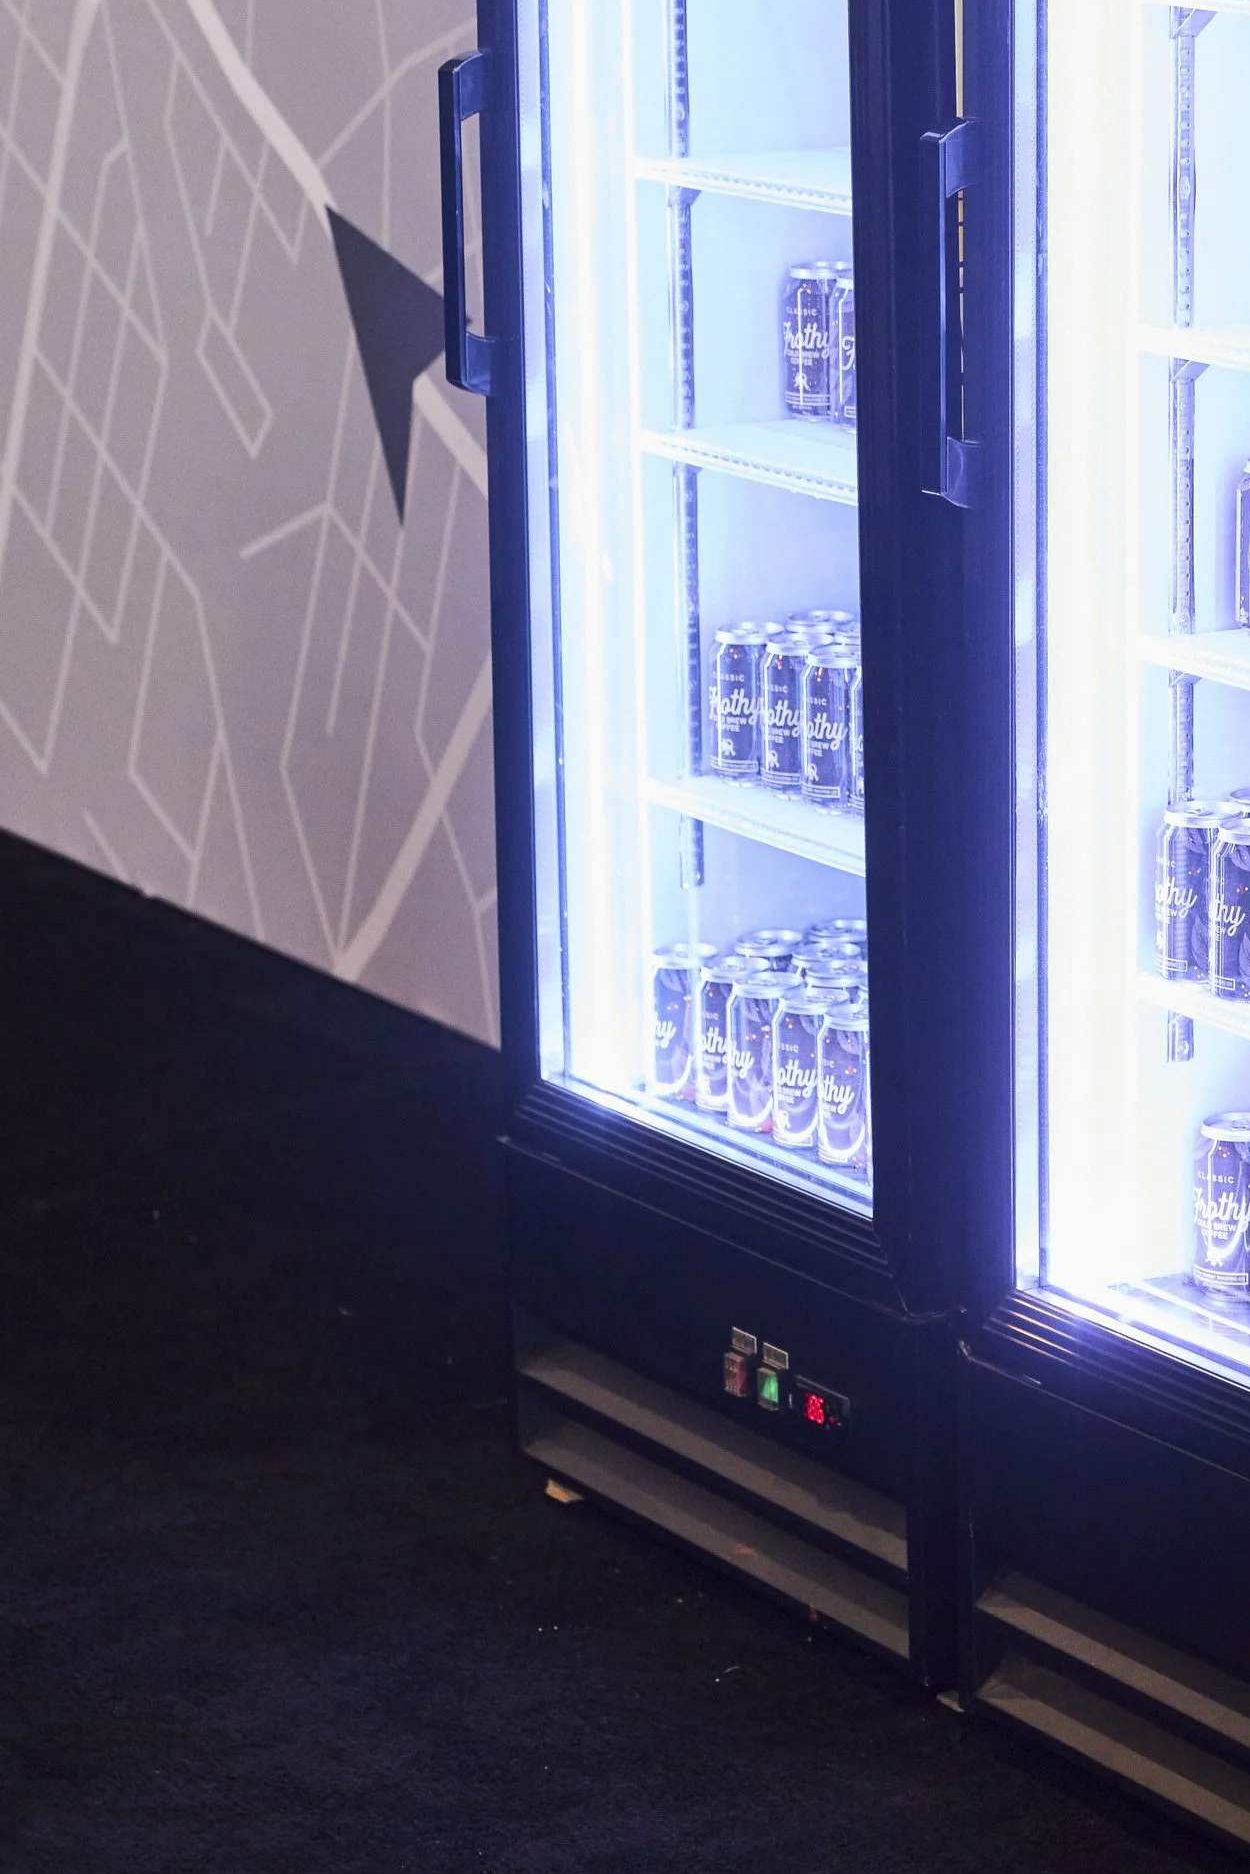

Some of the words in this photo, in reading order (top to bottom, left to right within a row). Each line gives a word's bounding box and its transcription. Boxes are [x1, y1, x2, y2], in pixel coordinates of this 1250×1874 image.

[712, 672, 745, 682] CSSIC
[762, 699, 804, 738] othy
[804, 712, 849, 752] othy
[1155, 876, 1197, 919] othy
[1210, 894, 1246, 937] thy
[776, 1059, 817, 1099] othy
[820, 1074, 856, 1115] thy
